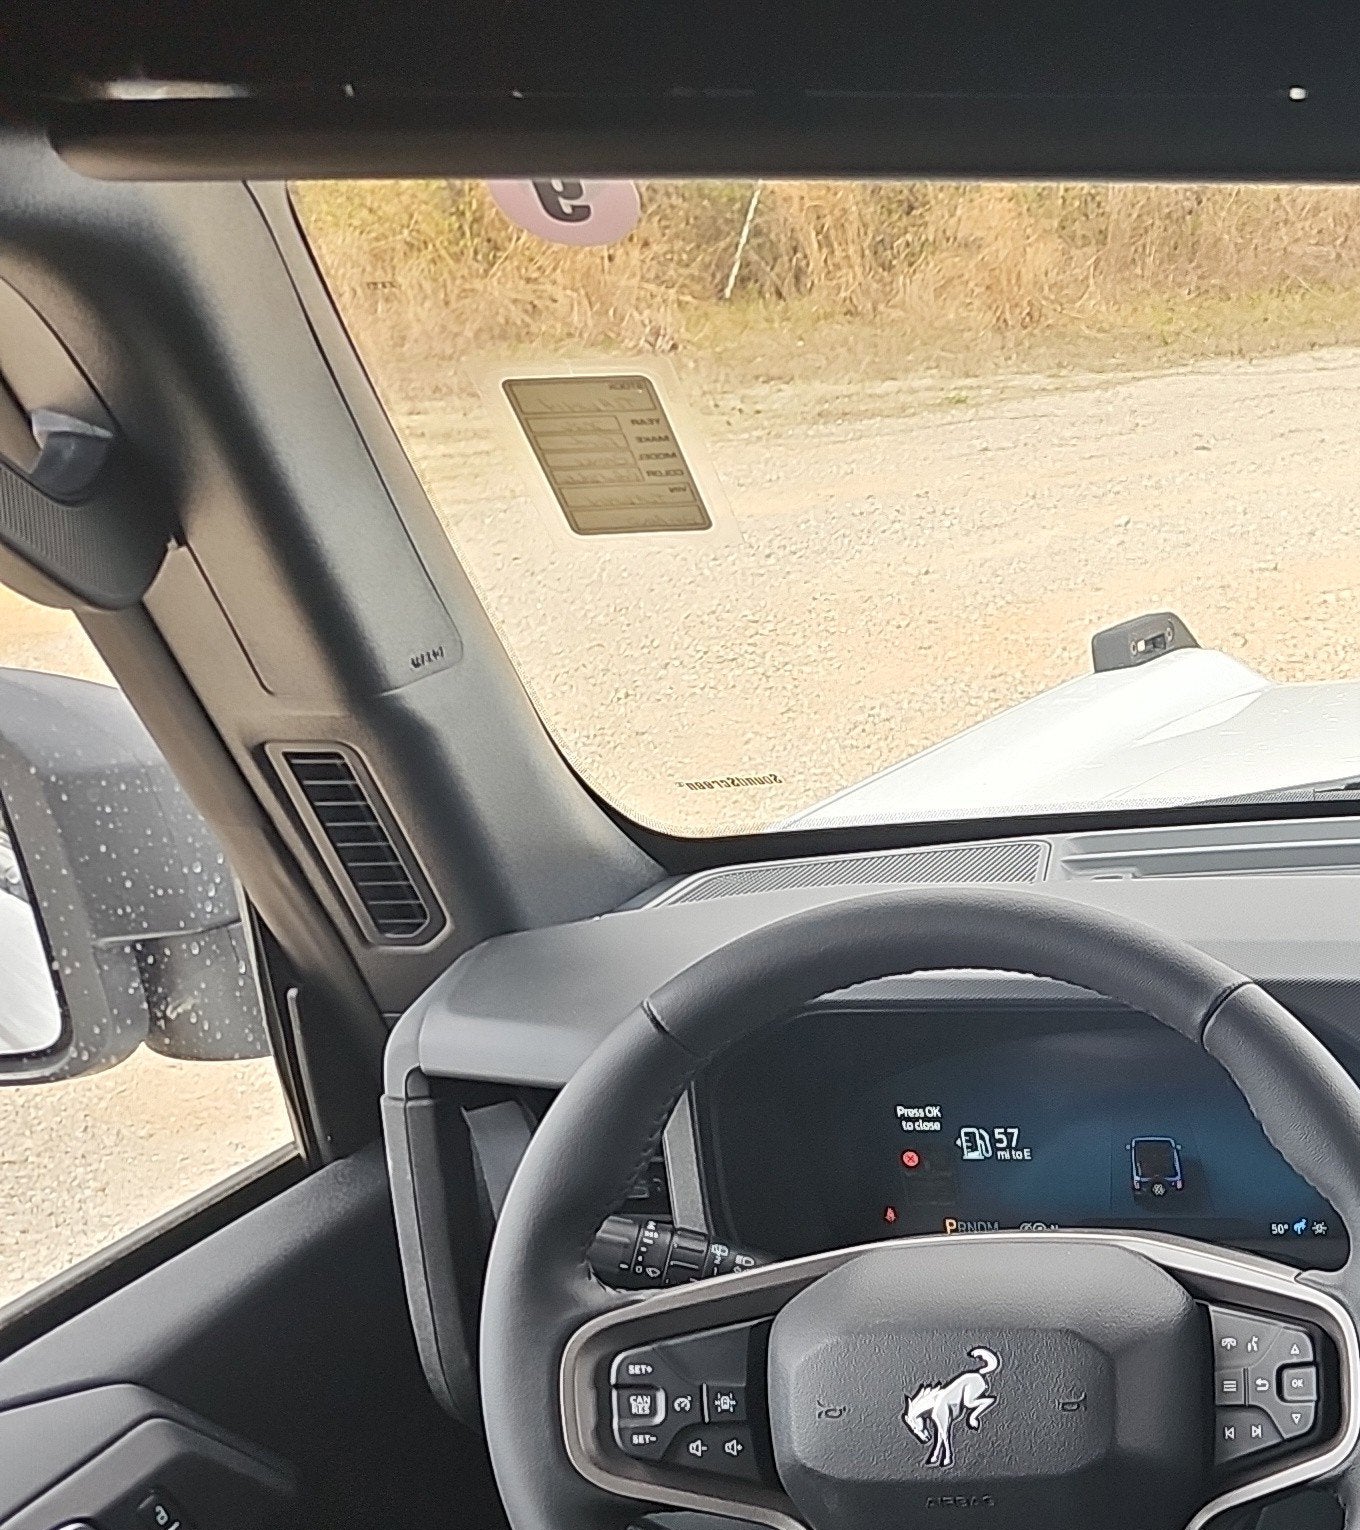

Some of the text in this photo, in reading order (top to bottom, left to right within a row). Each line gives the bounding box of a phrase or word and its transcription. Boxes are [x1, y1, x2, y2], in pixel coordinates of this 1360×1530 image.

[896, 1106, 942, 1118] Press OK
[902, 1119, 941, 1131] to close
[994, 1128, 1019, 1148] 57
[997, 1149, 1032, 1160] mi to E
[1291, 1378, 1303, 1388] OK
[630, 1395, 651, 1405] CAN
[632, 1404, 650, 1415] RES
